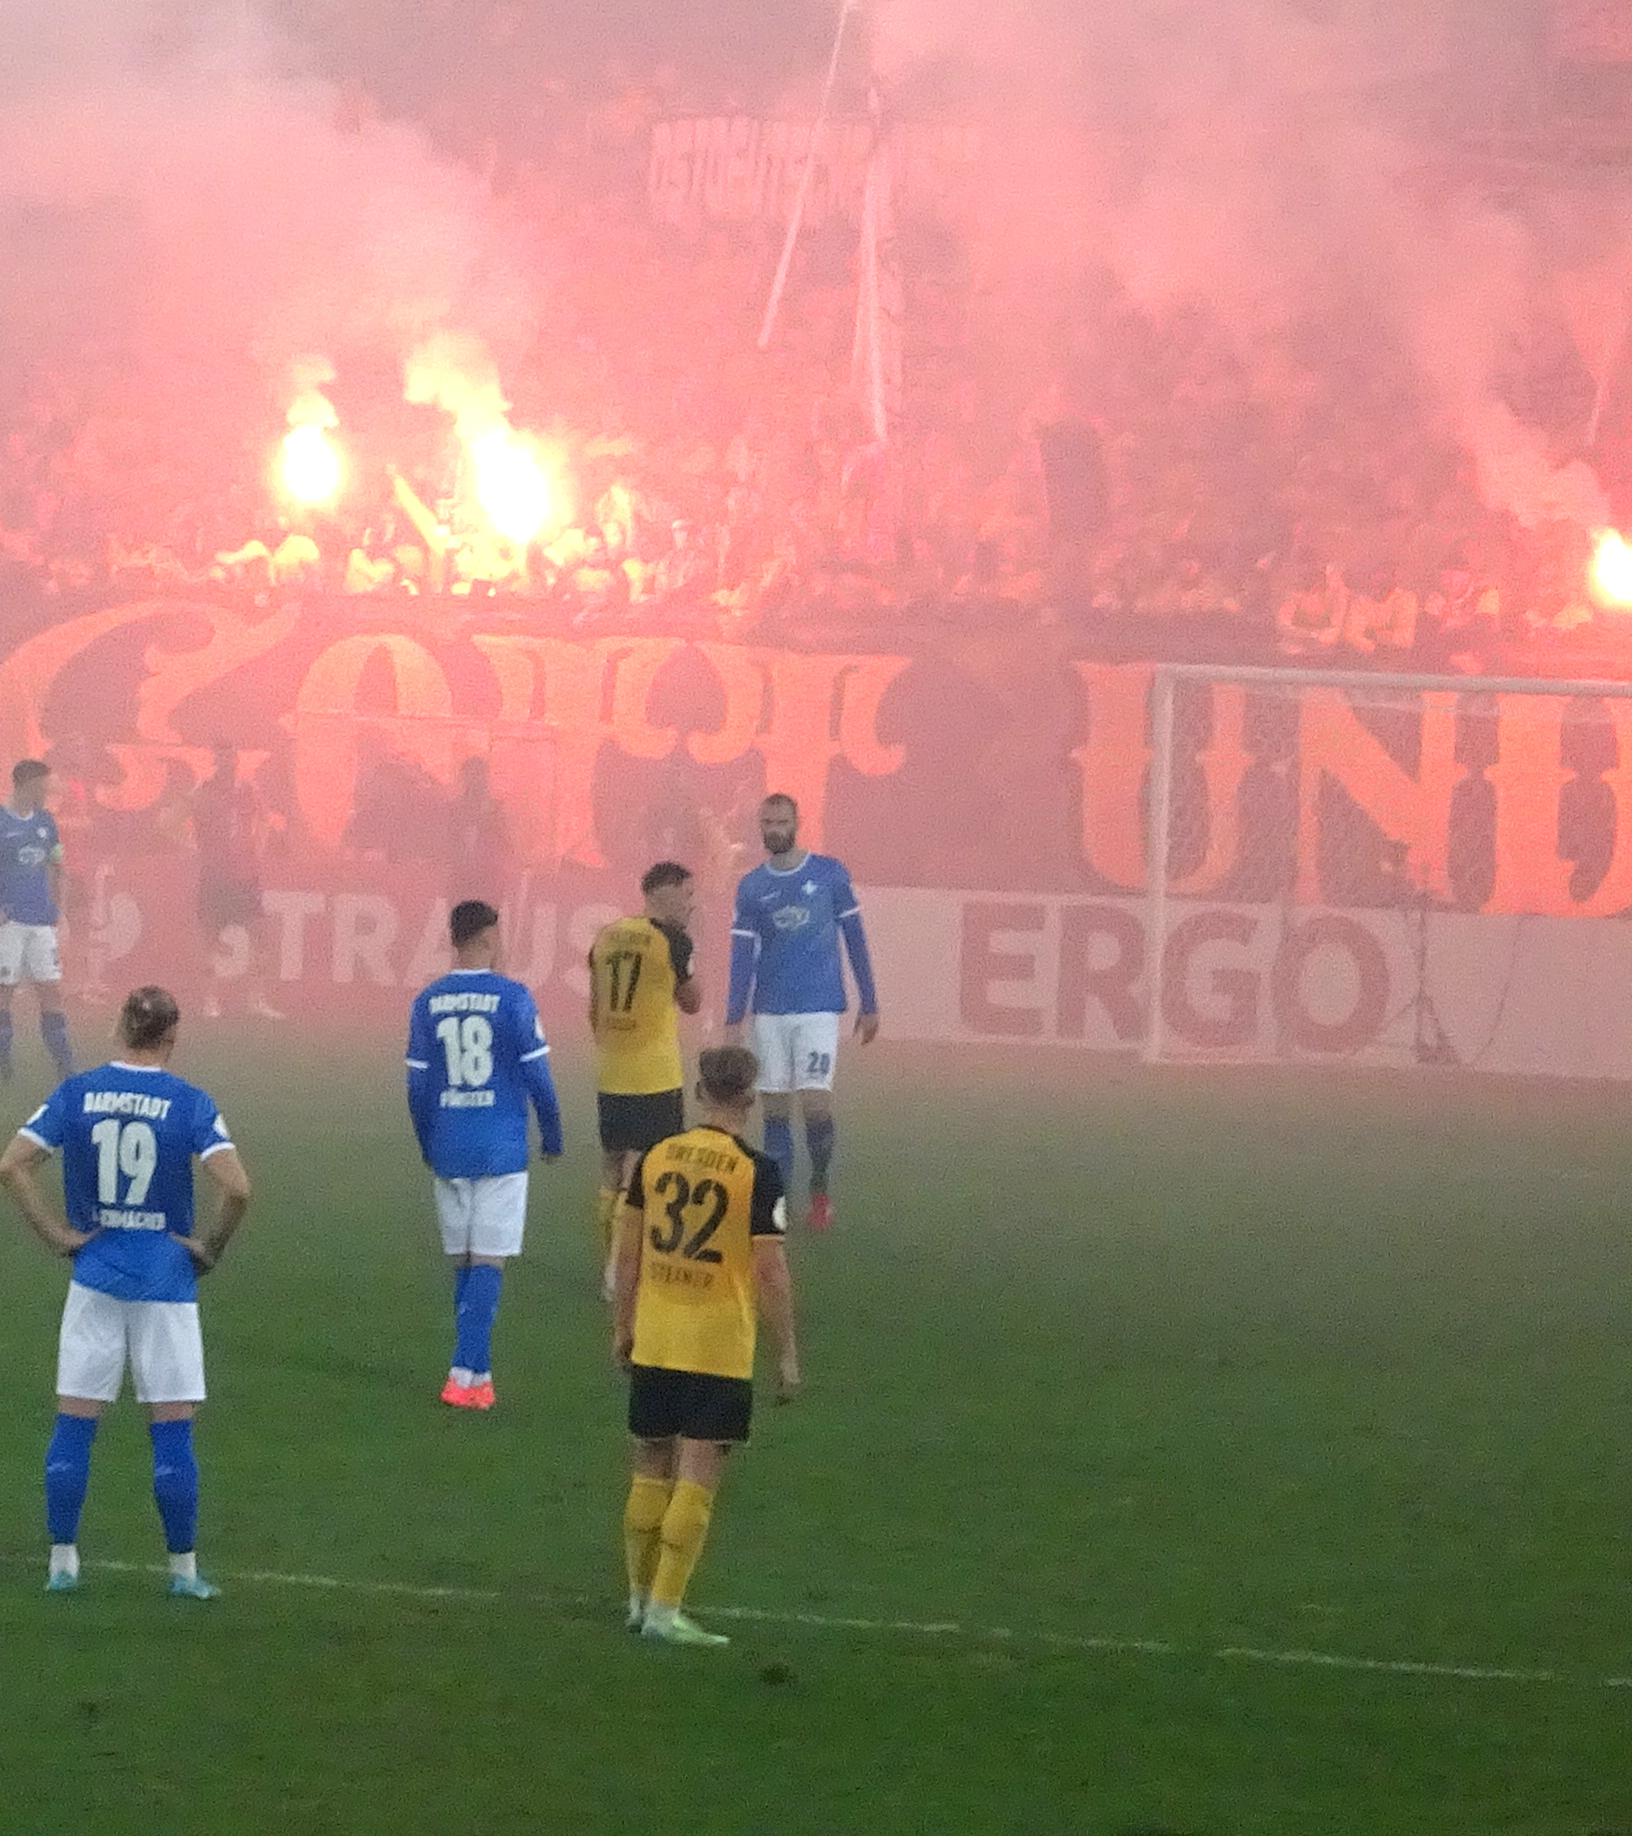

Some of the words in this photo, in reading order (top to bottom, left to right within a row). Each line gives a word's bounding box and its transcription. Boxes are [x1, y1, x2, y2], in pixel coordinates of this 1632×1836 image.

[605, 950, 642, 1012] 17
[959, 902, 1390, 1053] ERGO
[437, 1015, 494, 1087] 18
[83, 1091, 172, 1121] DARMSTADT
[91, 1117, 158, 1206] 19
[649, 1170, 729, 1263] 32
